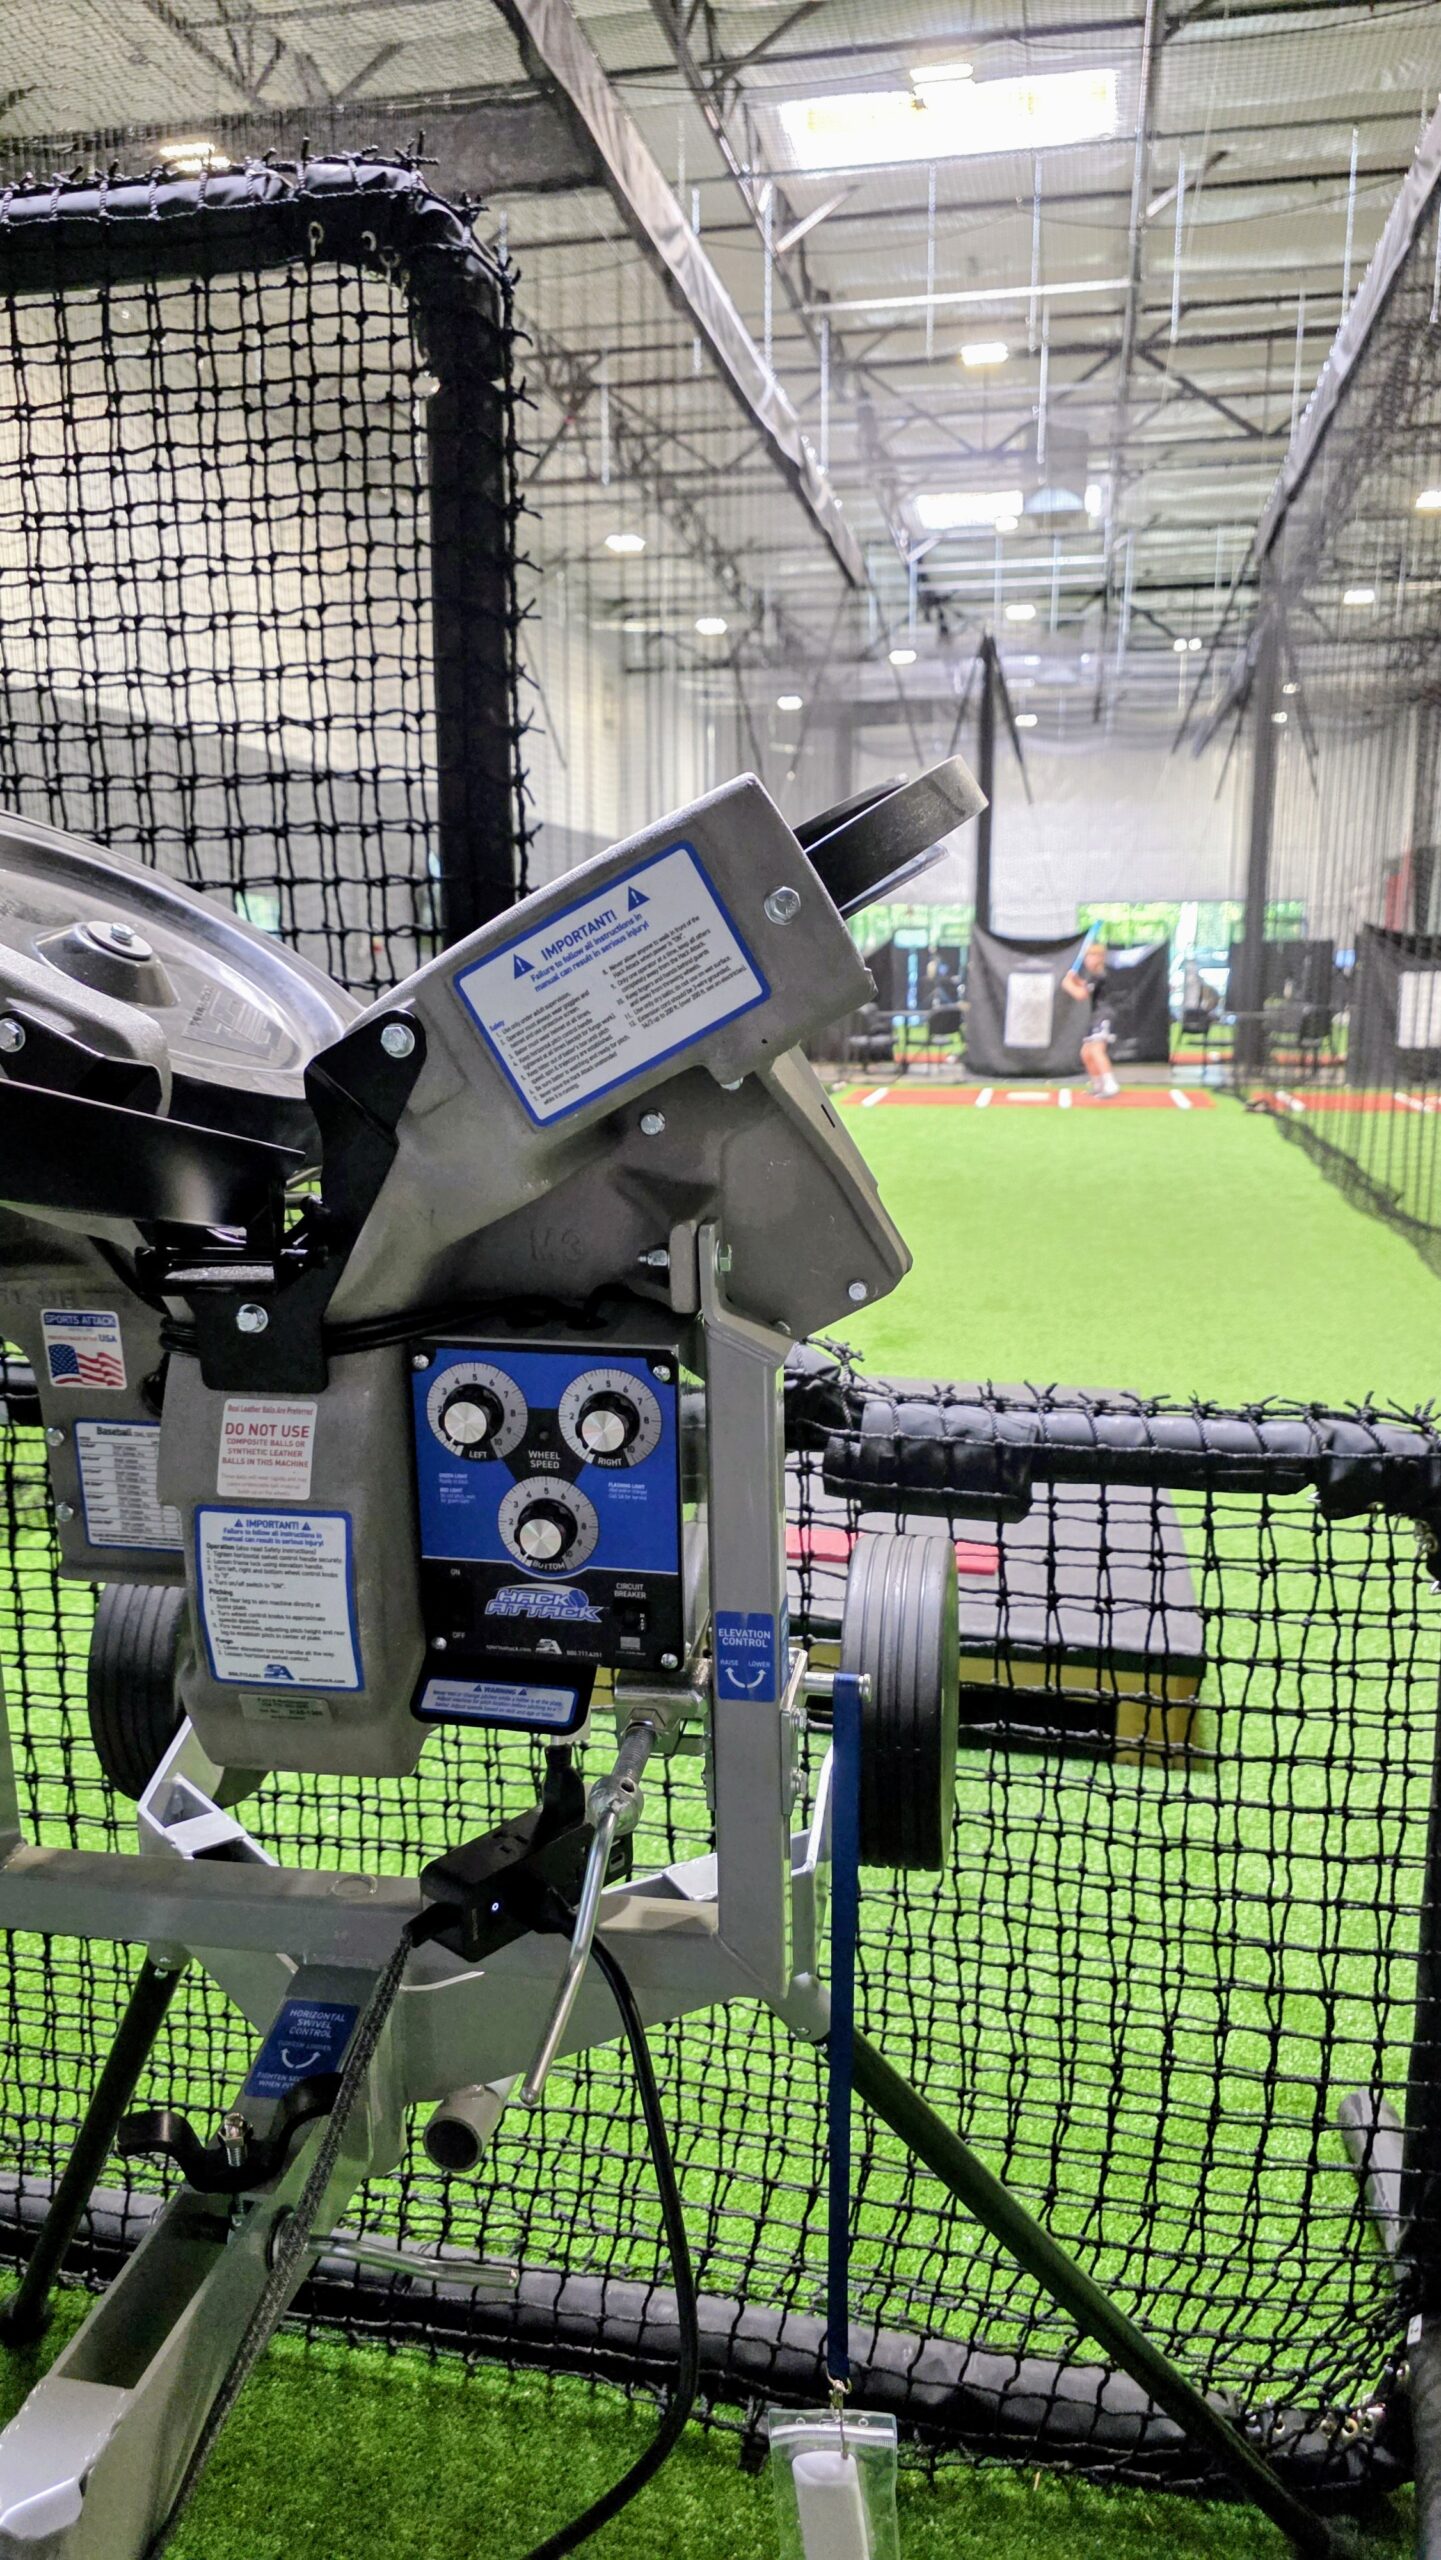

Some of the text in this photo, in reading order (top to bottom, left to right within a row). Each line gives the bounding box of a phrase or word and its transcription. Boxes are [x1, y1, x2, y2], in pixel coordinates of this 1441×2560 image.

[541, 909, 618, 961] IMPORTANT!
[530, 912, 643, 982] Failure to follow all instructions in
[534, 920, 650, 992] manual can result in serious injury!
[45, 1314, 116, 1326] SPORTS ATTACK
[98, 1334, 117, 1343] USA
[606, 1380, 611, 1388] 5
[240, 1405, 261, 1413] Leather
[286, 1407, 313, 1415] Preferred
[510, 1409, 516, 1417] 8
[225, 1422, 310, 1438] DO NOT USE
[226, 1438, 305, 1448] COMPOSITE BALLS OR
[227, 1448, 268, 1456] SYNTHETIC
[469, 1451, 487, 1459] LEFT
[529, 1450, 560, 1460] WHEEL
[257, 1458, 273, 1466] THIS
[274, 1460, 309, 1468] MACHINE
[530, 1460, 560, 1468] SPEED
[598, 1457, 622, 1466] RIGHT
[544, 1487, 549, 1495] 5
[575, 1504, 580, 1512] 7
[246, 1520, 299, 1530] IMPORTANT!
[305, 1539, 324, 1547] injury!
[532, 1560, 565, 1569] BOTTOM
[451, 1568, 460, 1576] ON
[496, 1588, 570, 1606] HACK
[614, 1590, 647, 1599] BREAKER
[485, 1600, 603, 1622] ATTACK
[718, 1628, 771, 1640] ELEVATION
[722, 1637, 768, 1648] CONTROL
[720, 1658, 739, 1666] RAISE
[748, 1660, 771, 1668] LOWER
[484, 1686, 516, 1695] WARNING
[289, 2009, 346, 2022] HORIZONTAL
[297, 2019, 332, 2029] SWIVEL
[289, 2027, 332, 2038] CONTROL
[256, 2072, 287, 2081] TIGHTEN
[258, 2080, 280, 2088] WHEN
